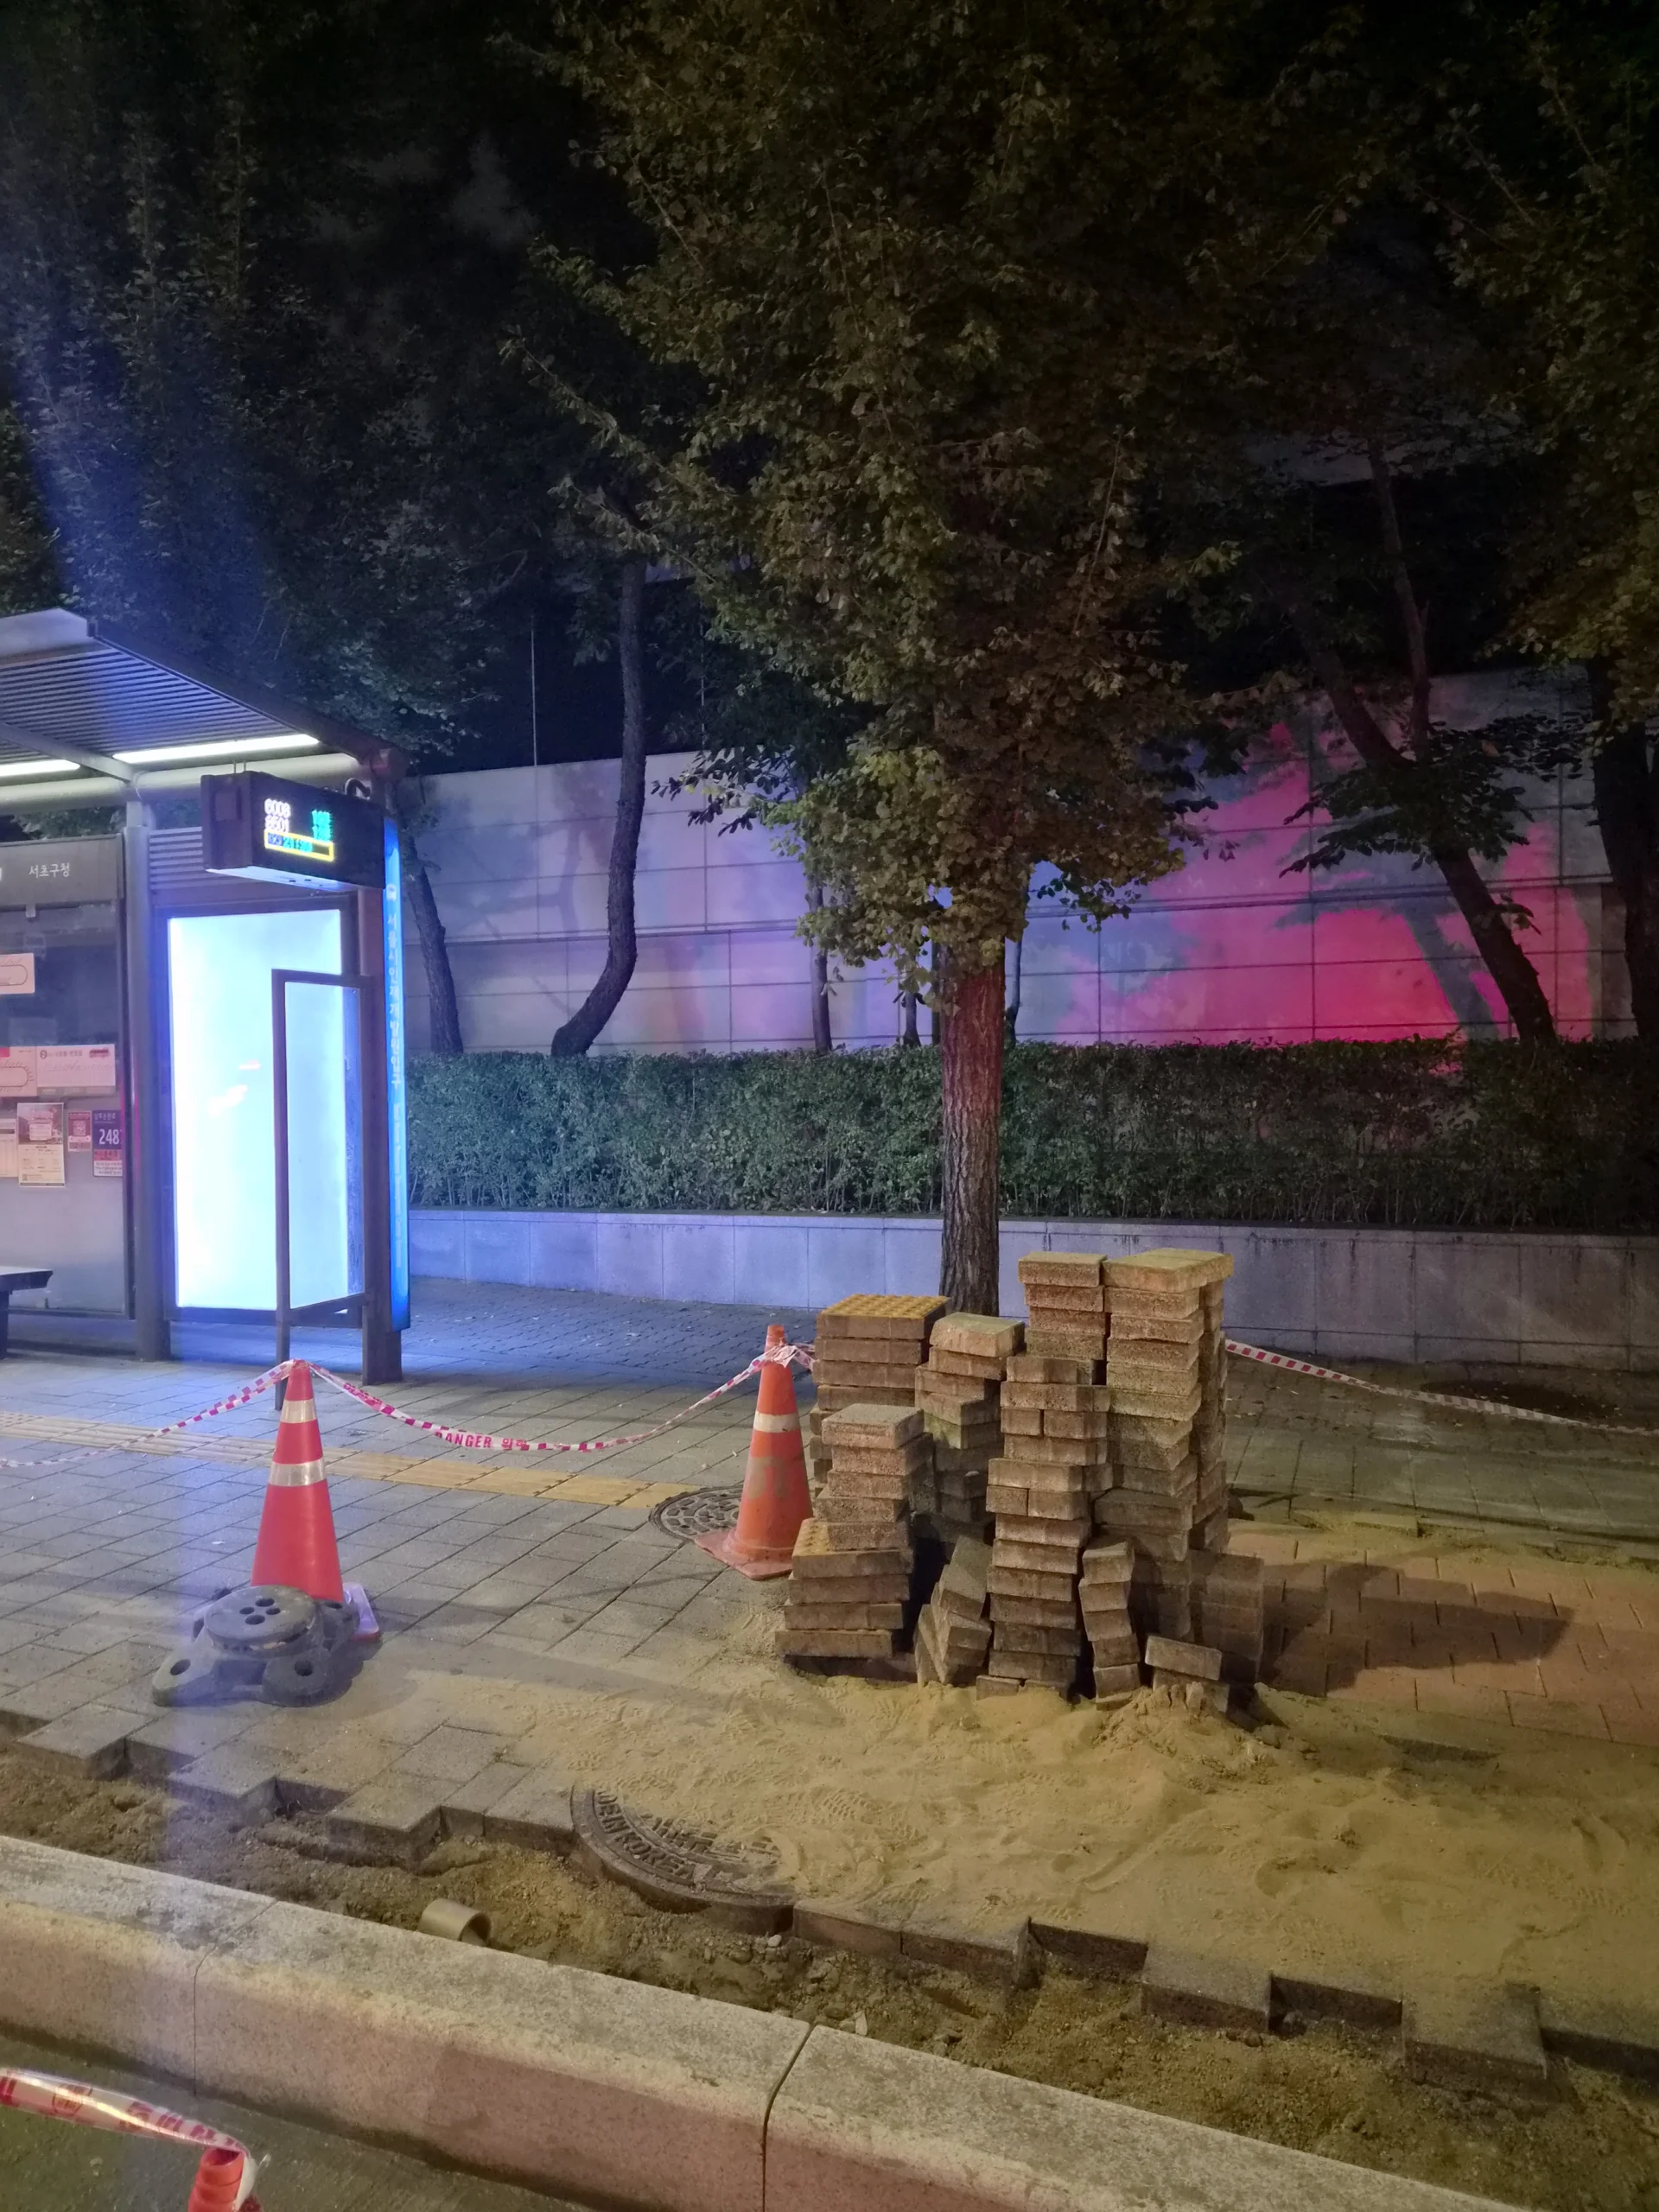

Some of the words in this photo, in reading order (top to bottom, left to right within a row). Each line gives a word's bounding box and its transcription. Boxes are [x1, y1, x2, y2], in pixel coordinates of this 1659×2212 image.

[29, 862, 70, 879] 서초구청
[387, 912, 403, 1090] 서울시인재개발원입구
[99, 1128, 123, 1145] 248
